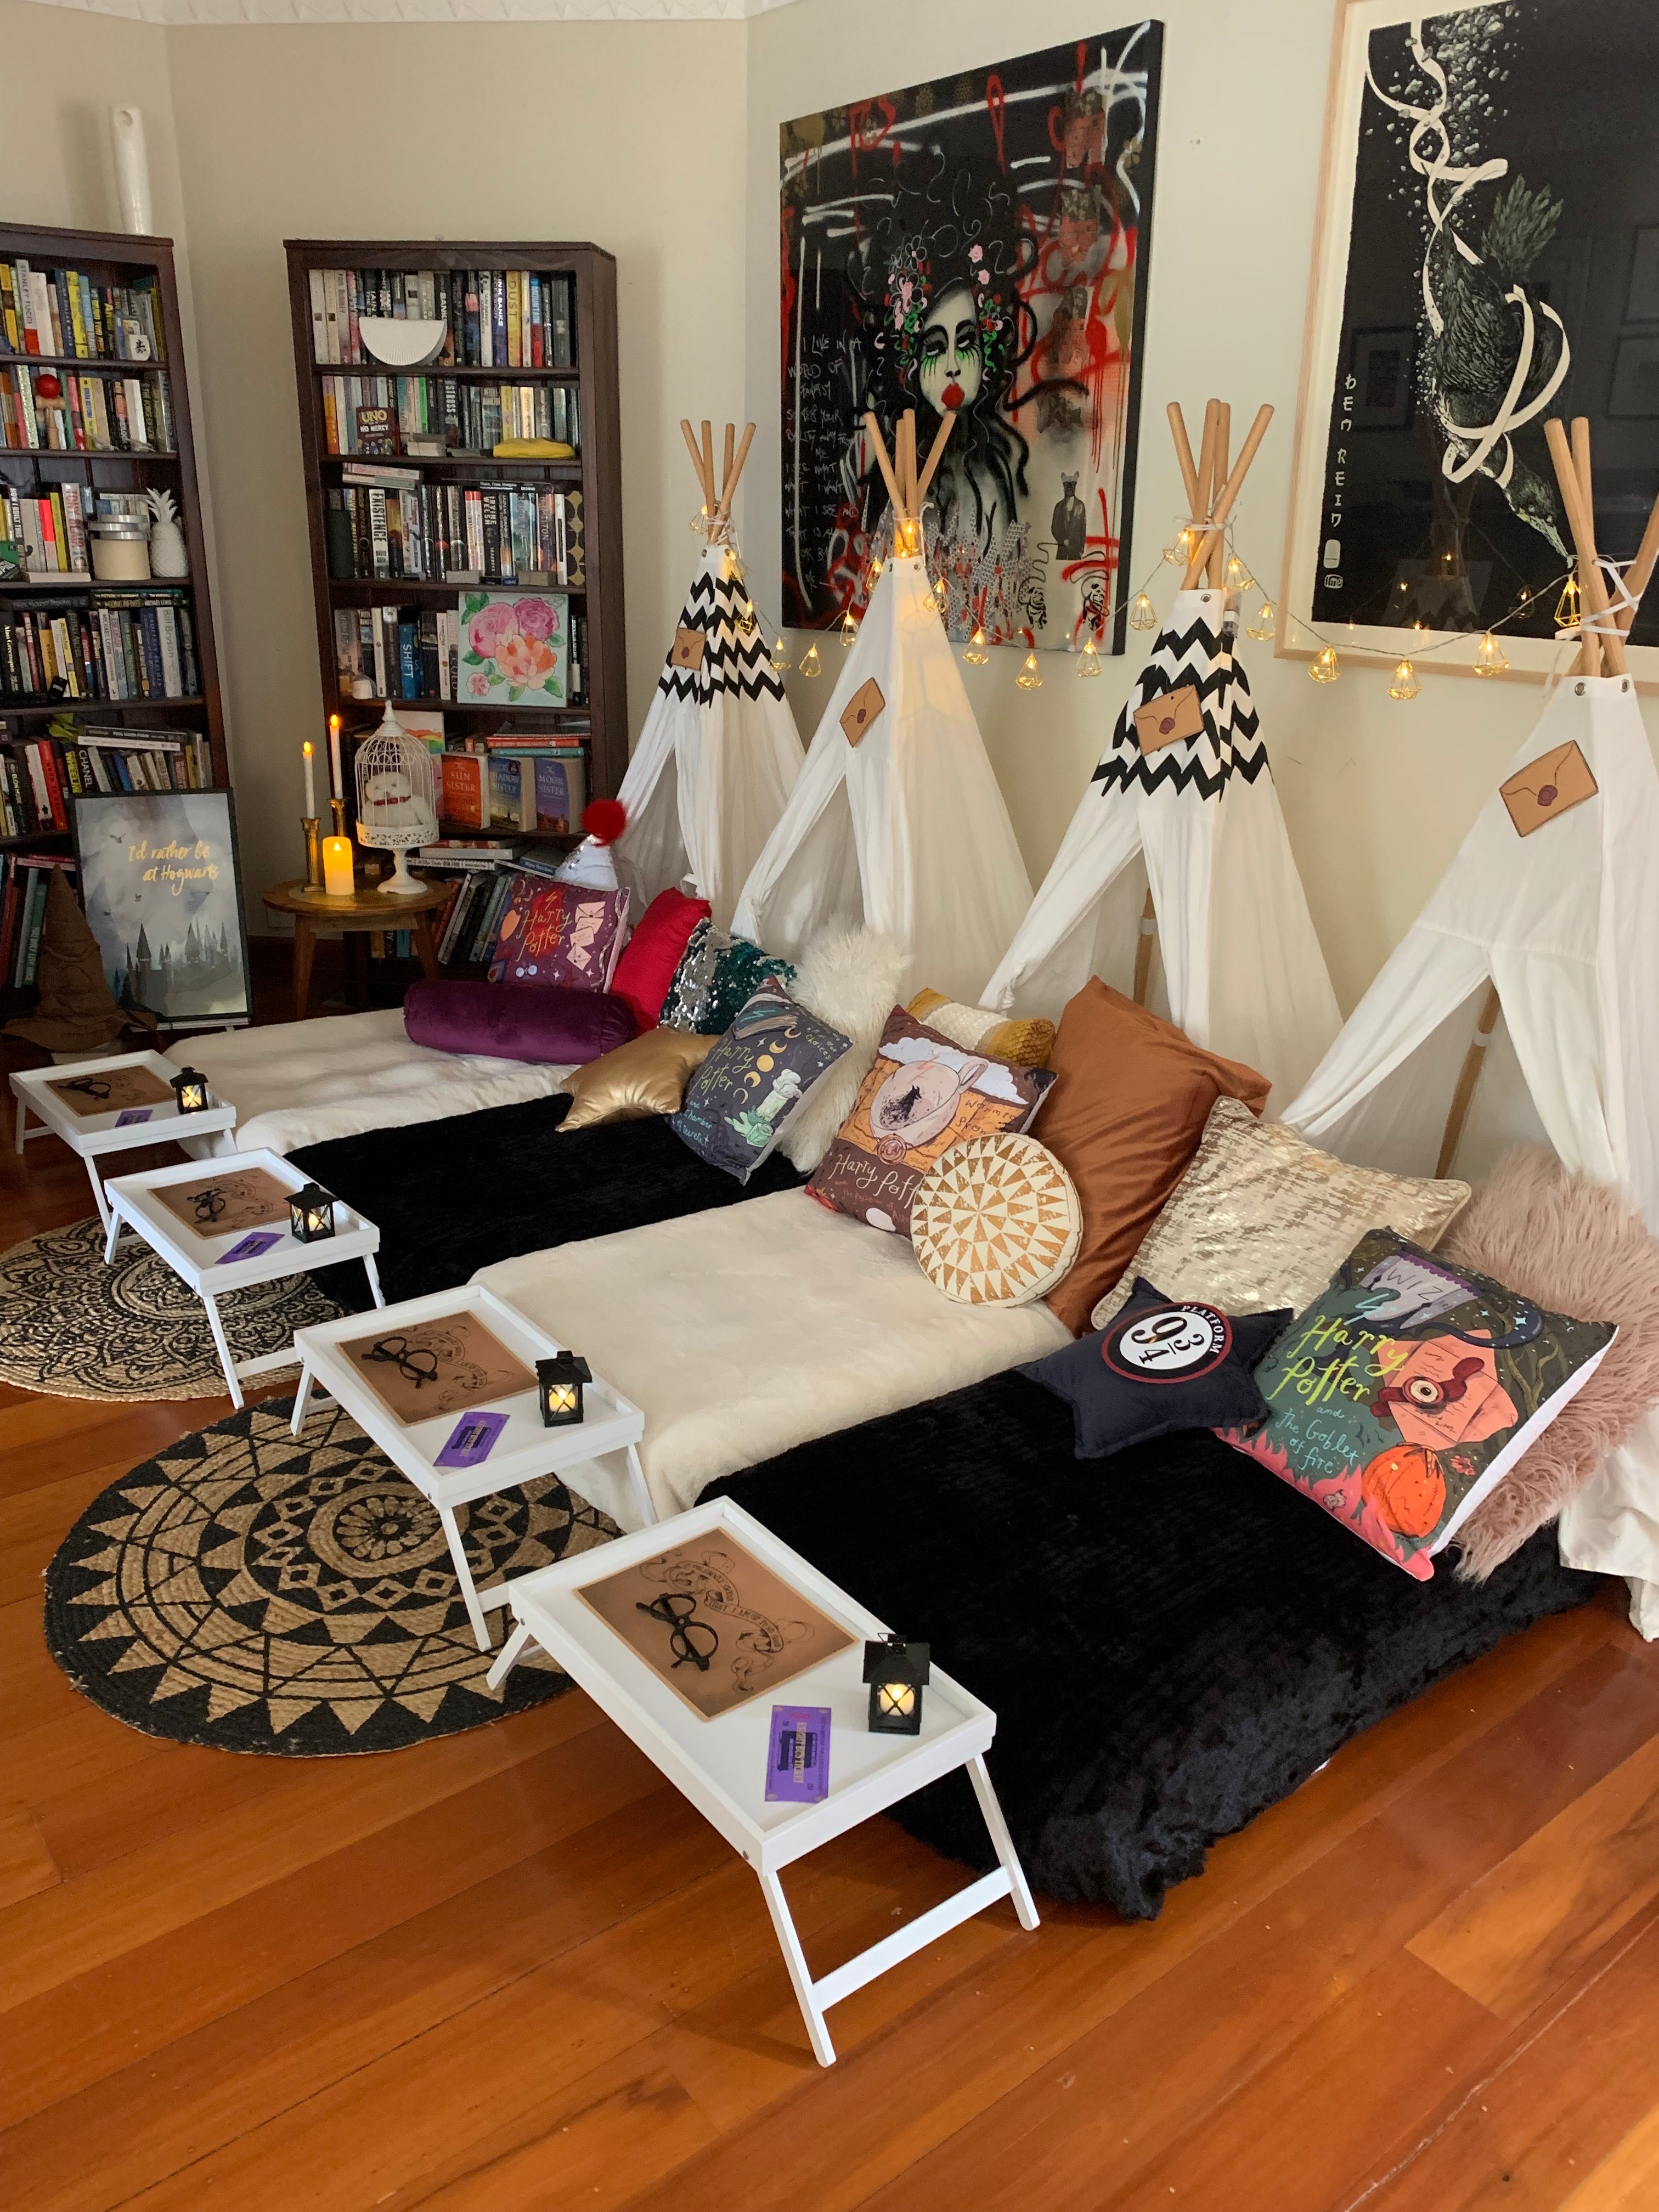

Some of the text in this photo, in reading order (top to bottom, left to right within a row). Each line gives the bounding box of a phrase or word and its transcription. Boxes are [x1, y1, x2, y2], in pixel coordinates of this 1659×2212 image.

[24, 301, 33, 325] TUCCI
[439, 292, 448, 321] BANK
[507, 280, 517, 319] DUST
[445, 385, 456, 414] STROSS
[360, 410, 387, 424] UNO
[12, 507, 21, 523] BUILT
[373, 493, 387, 542] EXISTENCE
[15, 524, 23, 538] THIS
[101, 613, 110, 636] MICHAEL
[163, 609, 174, 658] Bill Bryson
[6, 640, 15, 673] Greenspan
[403, 644, 414, 679] SHIFT
[12, 774, 21, 788] ELON
[78, 749, 93, 788] CHANEL
[451, 771, 470, 782] SUN
[538, 773, 563, 786] MOON
[447, 781, 476, 792] SISTER
[539, 785, 565, 795] SISTER
[128, 840, 211, 862] I'd rather be
[142, 865, 219, 896] at Hogwarts
[516, 907, 572, 940] Harry
[515, 924, 566, 962] Potter
[704, 1037, 754, 1074] Harry
[687, 1063, 733, 1096] Potter
[683, 1109, 713, 1130] Chamber
[827, 1153, 921, 1209] Harry Pott
[1386, 1267, 1443, 1301] WIZ
[1180, 1305, 1224, 1354] PLATFORM
[1286, 1314, 1408, 1377] Harry
[1265, 1355, 1370, 1406] Potter
[1316, 1406, 1345, 1419] and
[1289, 1437, 1306, 1454] of
[1305, 1419, 1359, 1466] Goblet
[708, 1596, 729, 1612] THAT
[738, 1609, 751, 1617] AM
